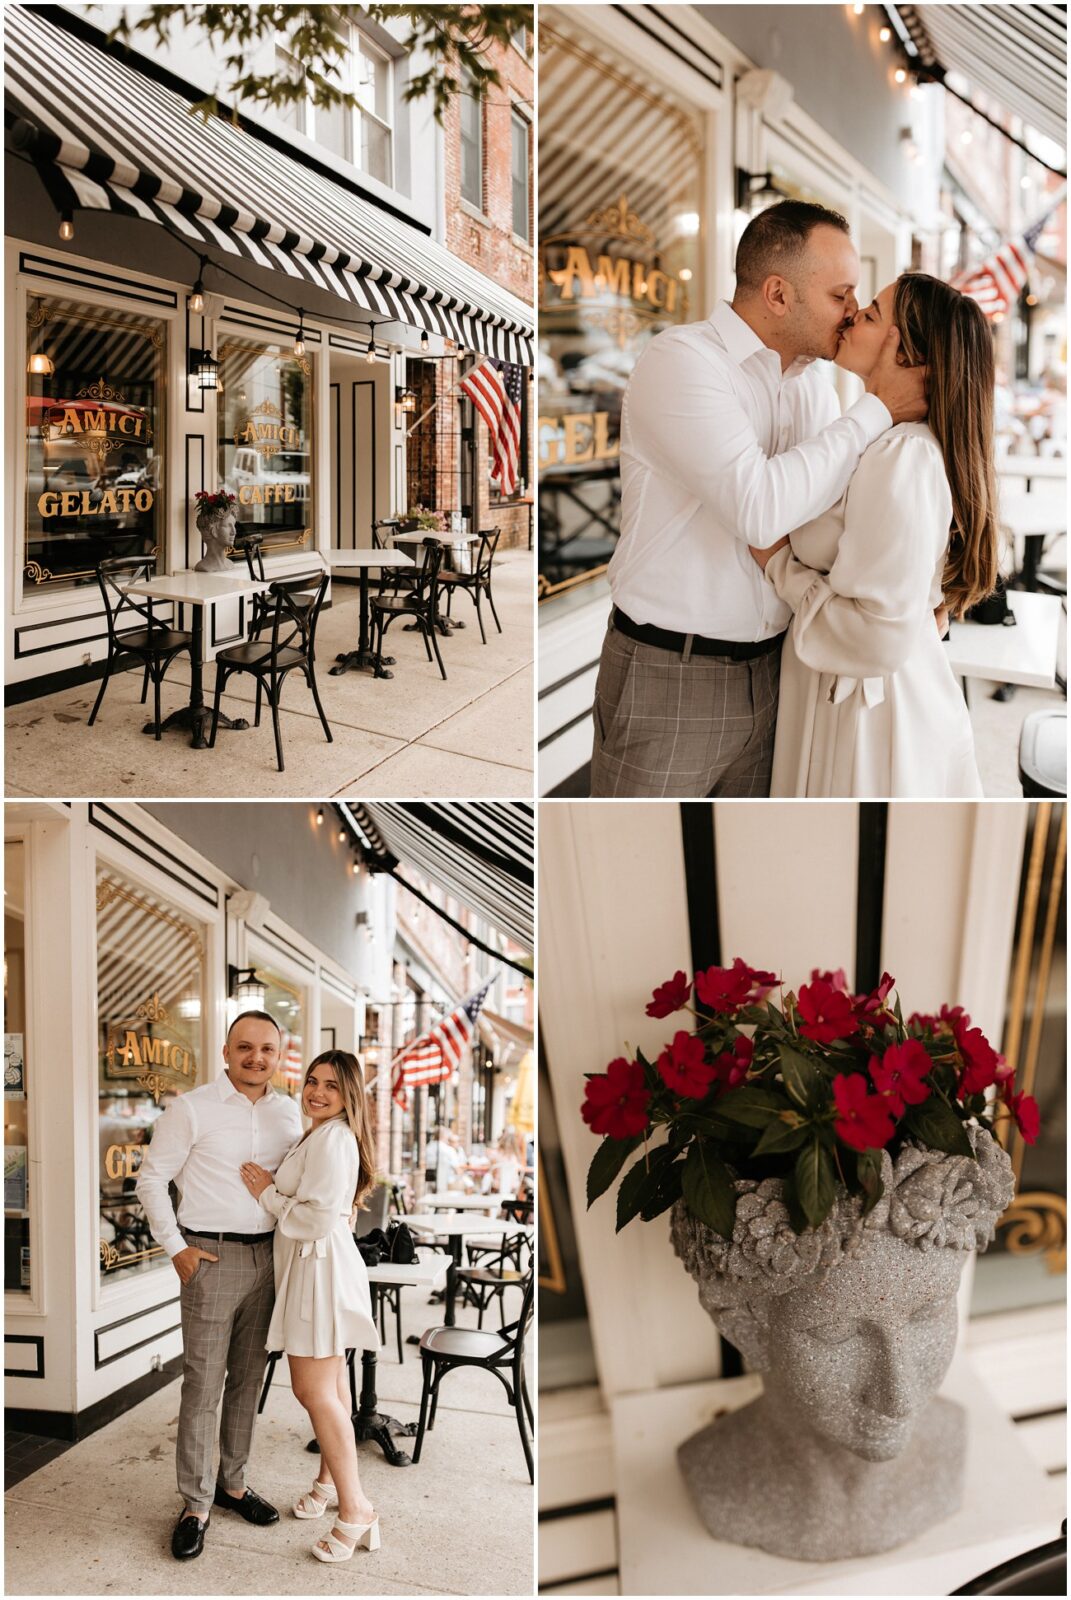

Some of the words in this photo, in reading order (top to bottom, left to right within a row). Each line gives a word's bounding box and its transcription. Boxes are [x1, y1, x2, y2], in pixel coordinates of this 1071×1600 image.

[549, 246, 677, 313] AMICI
[53, 408, 142, 437] AMICI
[240, 421, 296, 444] AMICI
[37, 489, 153, 518] GELATO
[116, 1030, 190, 1075] AMICI
[105, 1144, 149, 1179] GE
